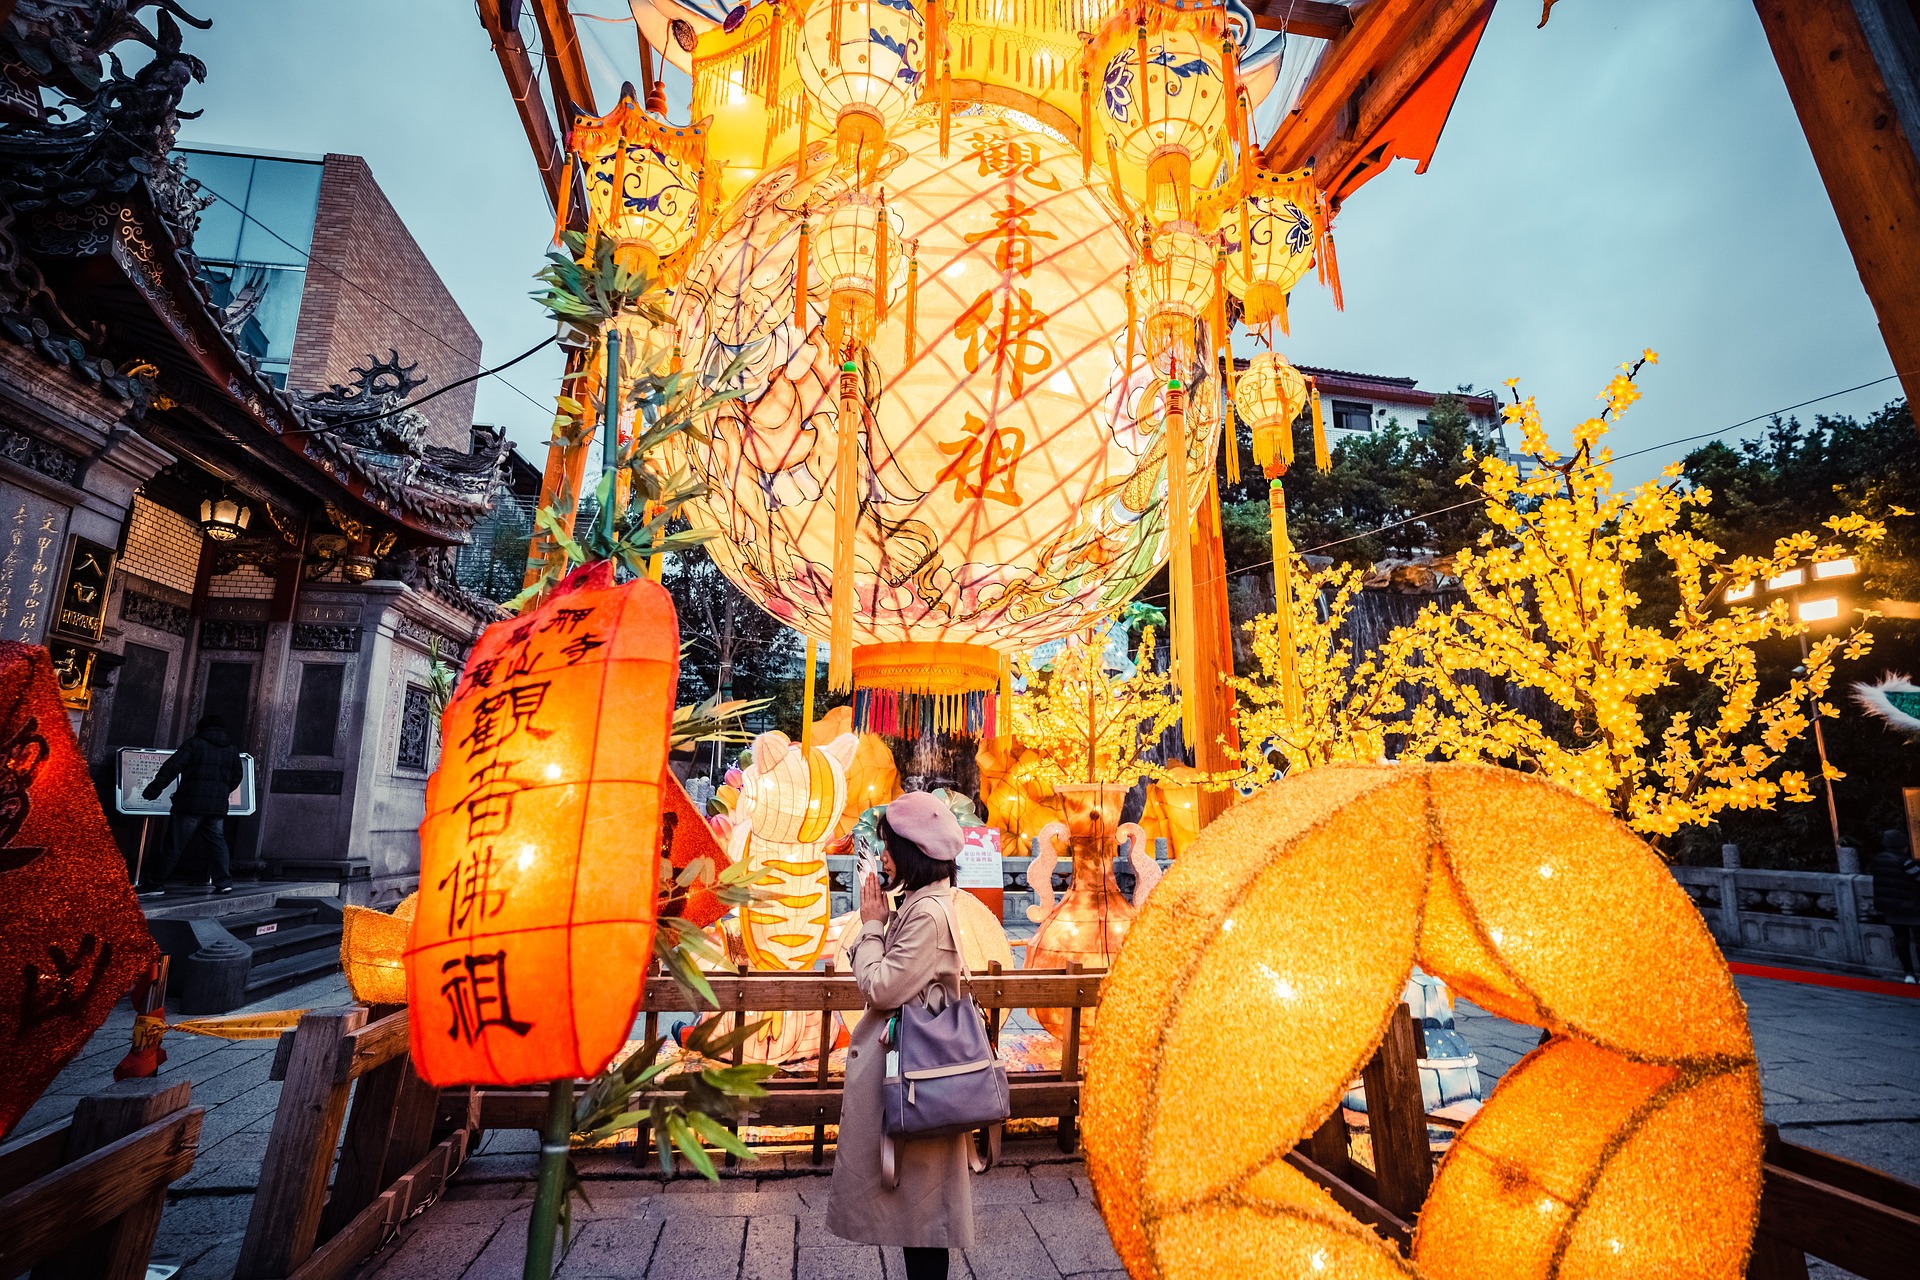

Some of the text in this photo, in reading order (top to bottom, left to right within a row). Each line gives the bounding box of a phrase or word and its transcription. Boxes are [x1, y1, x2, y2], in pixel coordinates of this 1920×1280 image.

[936, 132, 1062, 507] 觀音佛祖
[73, 552, 106, 604] 入口
[438, 680, 556, 1046] 觀音佛祖
